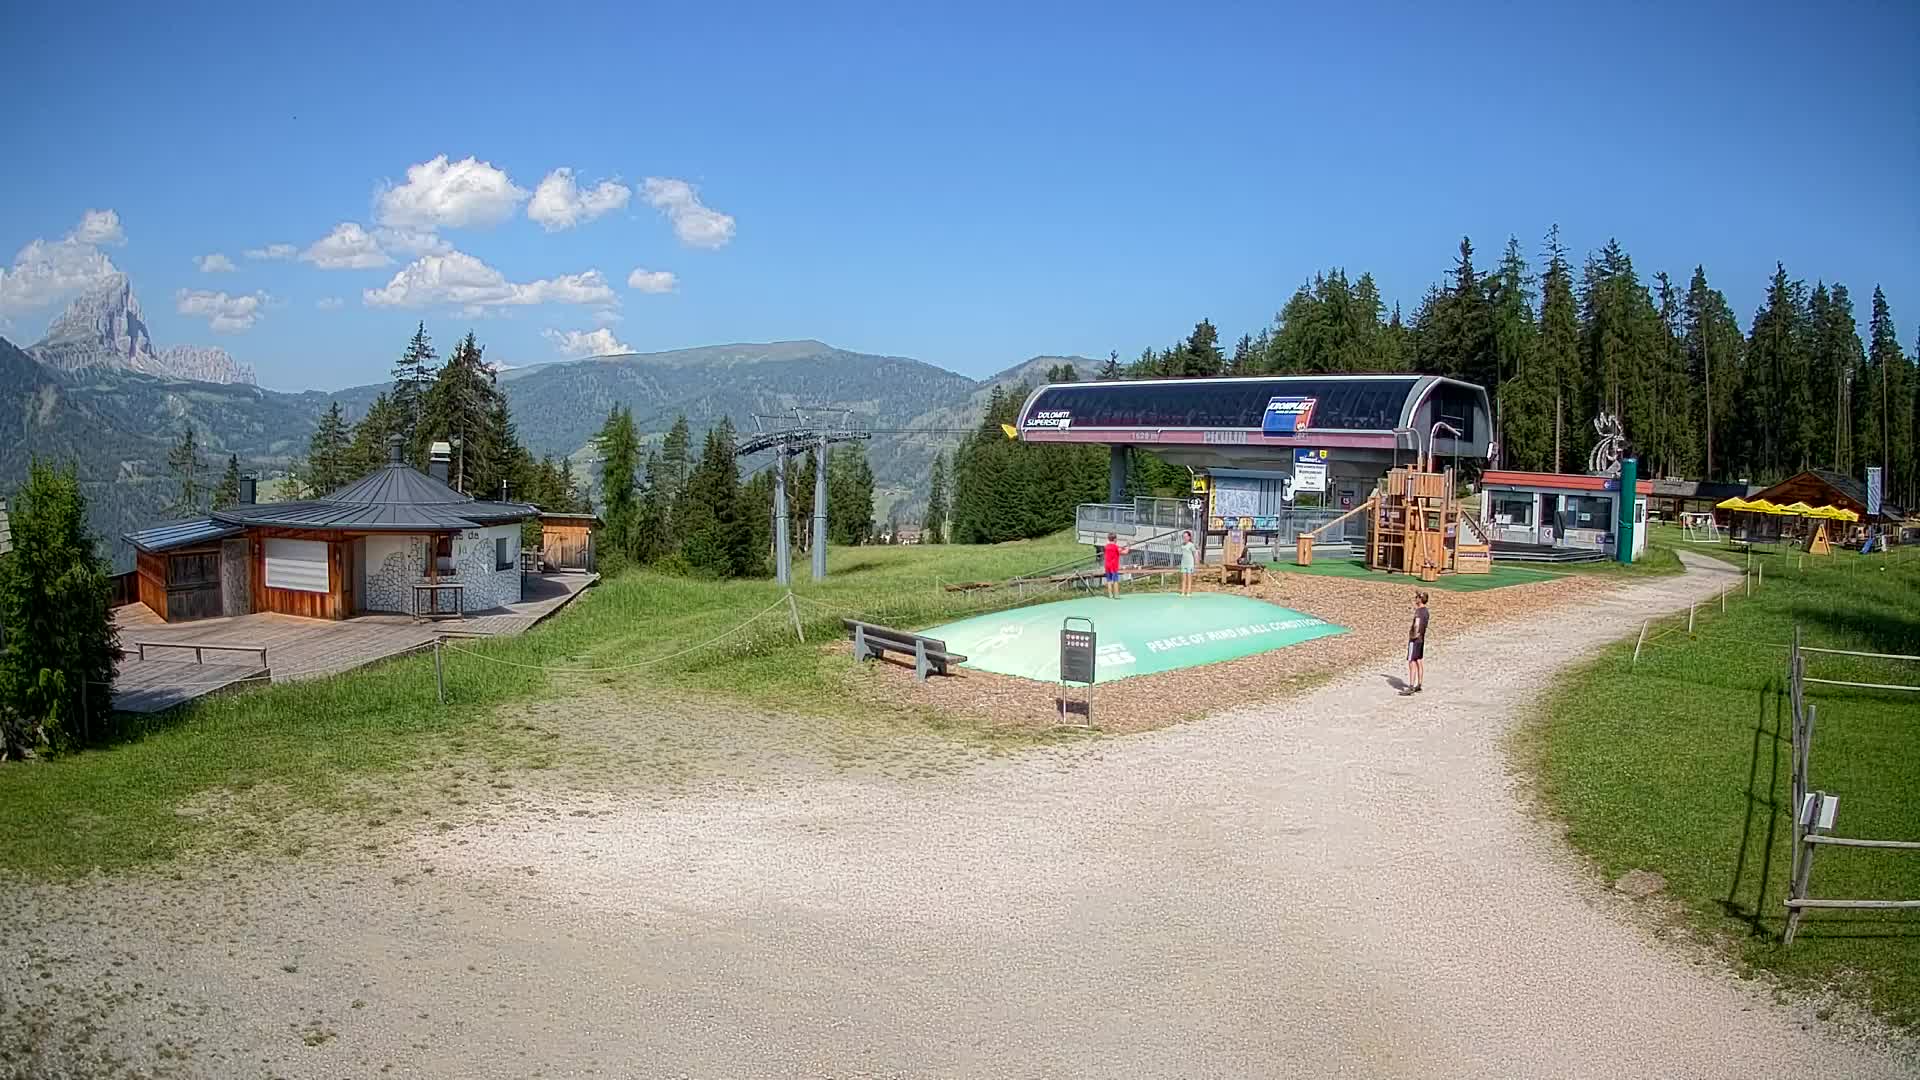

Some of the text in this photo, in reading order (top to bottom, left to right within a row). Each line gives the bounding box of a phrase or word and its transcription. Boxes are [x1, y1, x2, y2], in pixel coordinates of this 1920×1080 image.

[1203, 431, 1247, 444] PICULIN
[1145, 635, 1191, 653] PEACE
[1189, 633, 1205, 645] OF
[1206, 628, 1237, 640] MIND
[1235, 626, 1251, 637] IN
[1249, 624, 1271, 633] ALL
